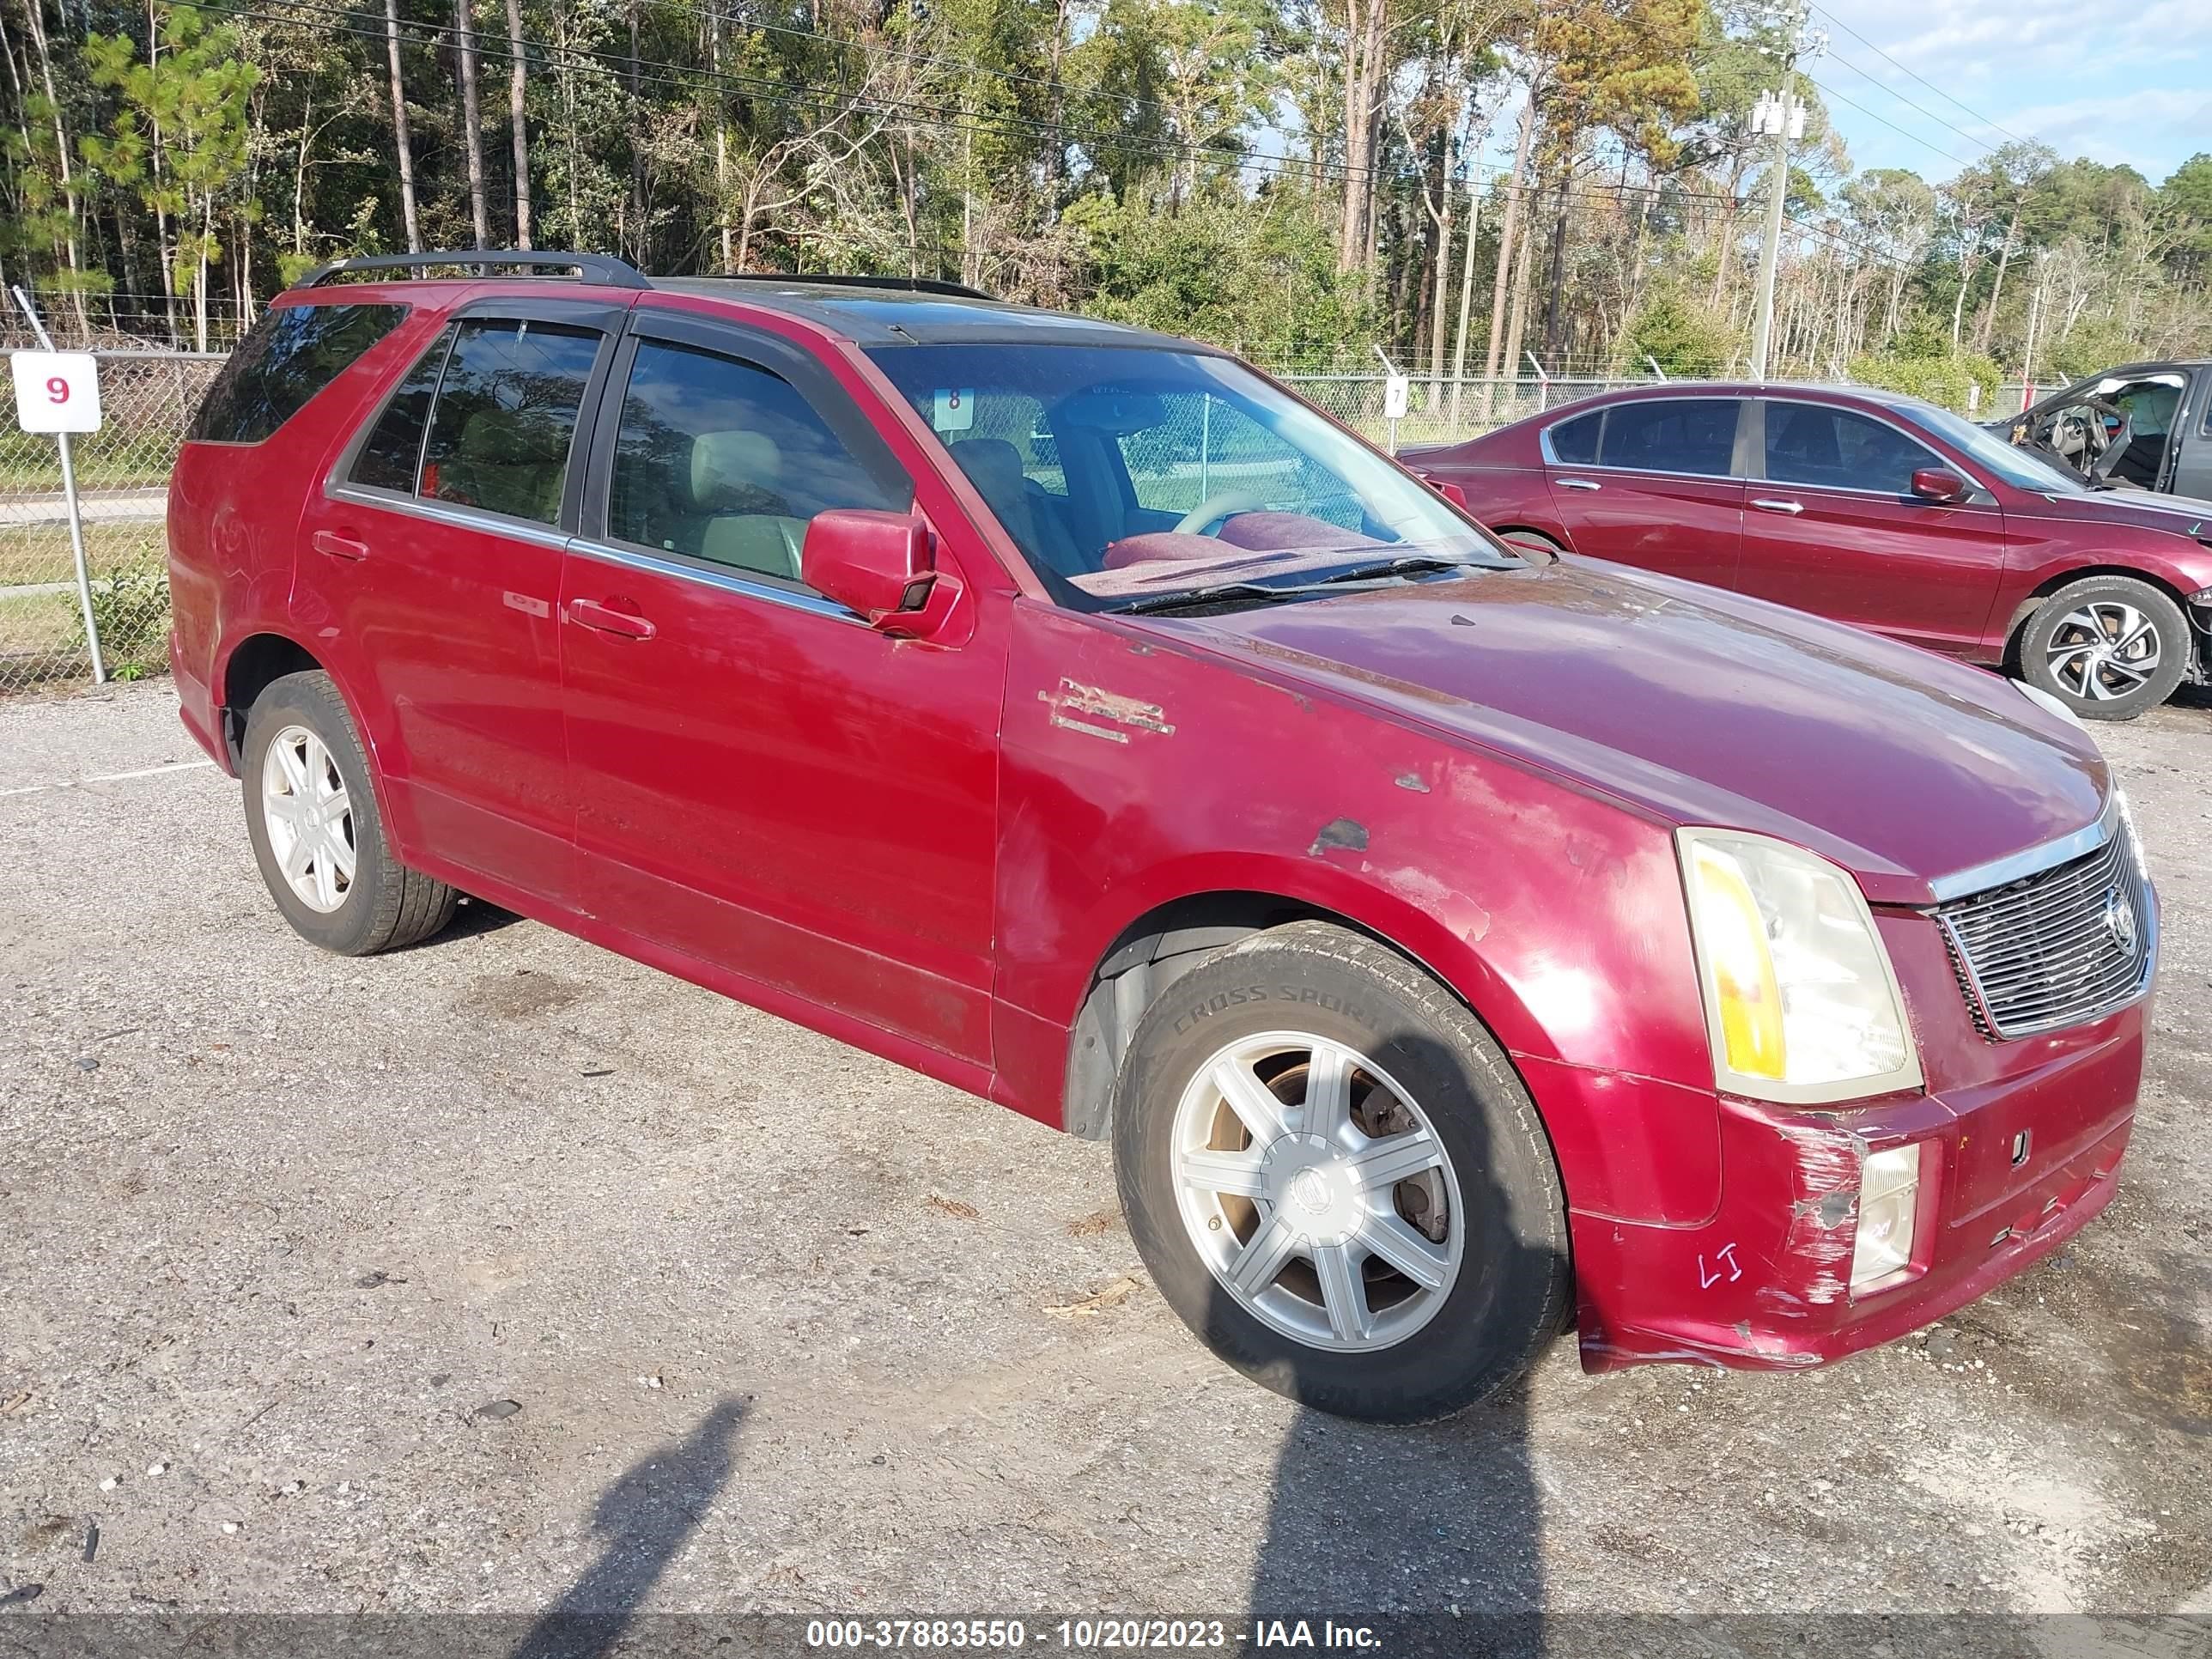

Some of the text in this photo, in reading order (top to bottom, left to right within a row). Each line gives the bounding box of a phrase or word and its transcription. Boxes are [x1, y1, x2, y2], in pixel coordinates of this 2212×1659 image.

[46, 377, 70, 404] 9
[949, 387, 961, 410] 8
[1395, 389, 1401, 404] 7
[1173, 985, 1381, 1036] CROSS SPORT
